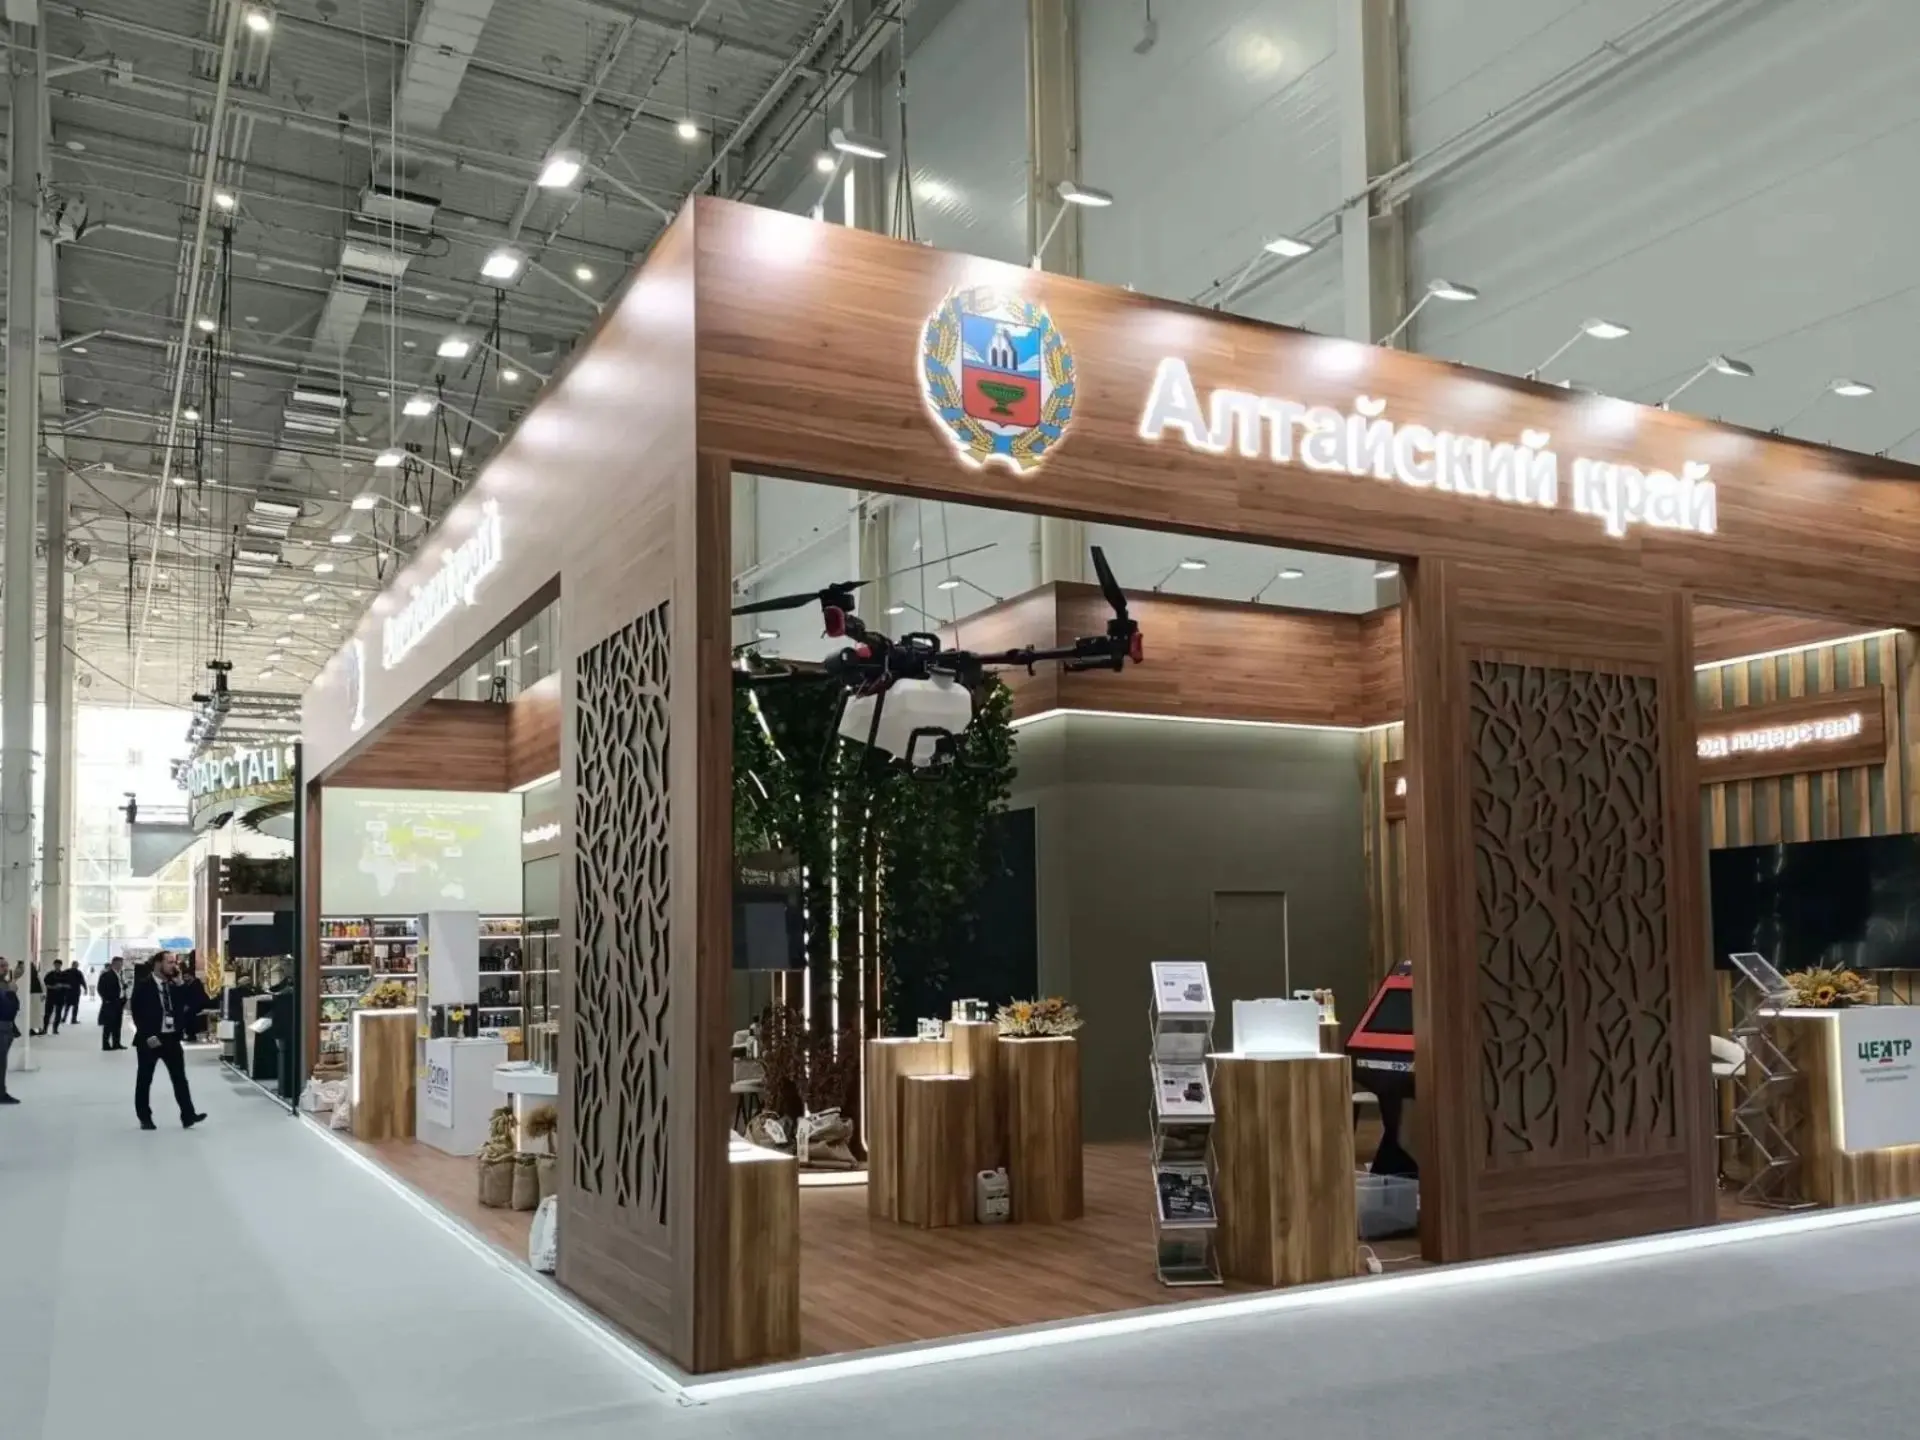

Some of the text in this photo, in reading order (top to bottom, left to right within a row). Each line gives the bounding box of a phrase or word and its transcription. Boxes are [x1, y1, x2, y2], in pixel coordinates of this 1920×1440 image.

[1139, 356, 1718, 538] Алтайский край
[1697, 735, 1729, 758] од
